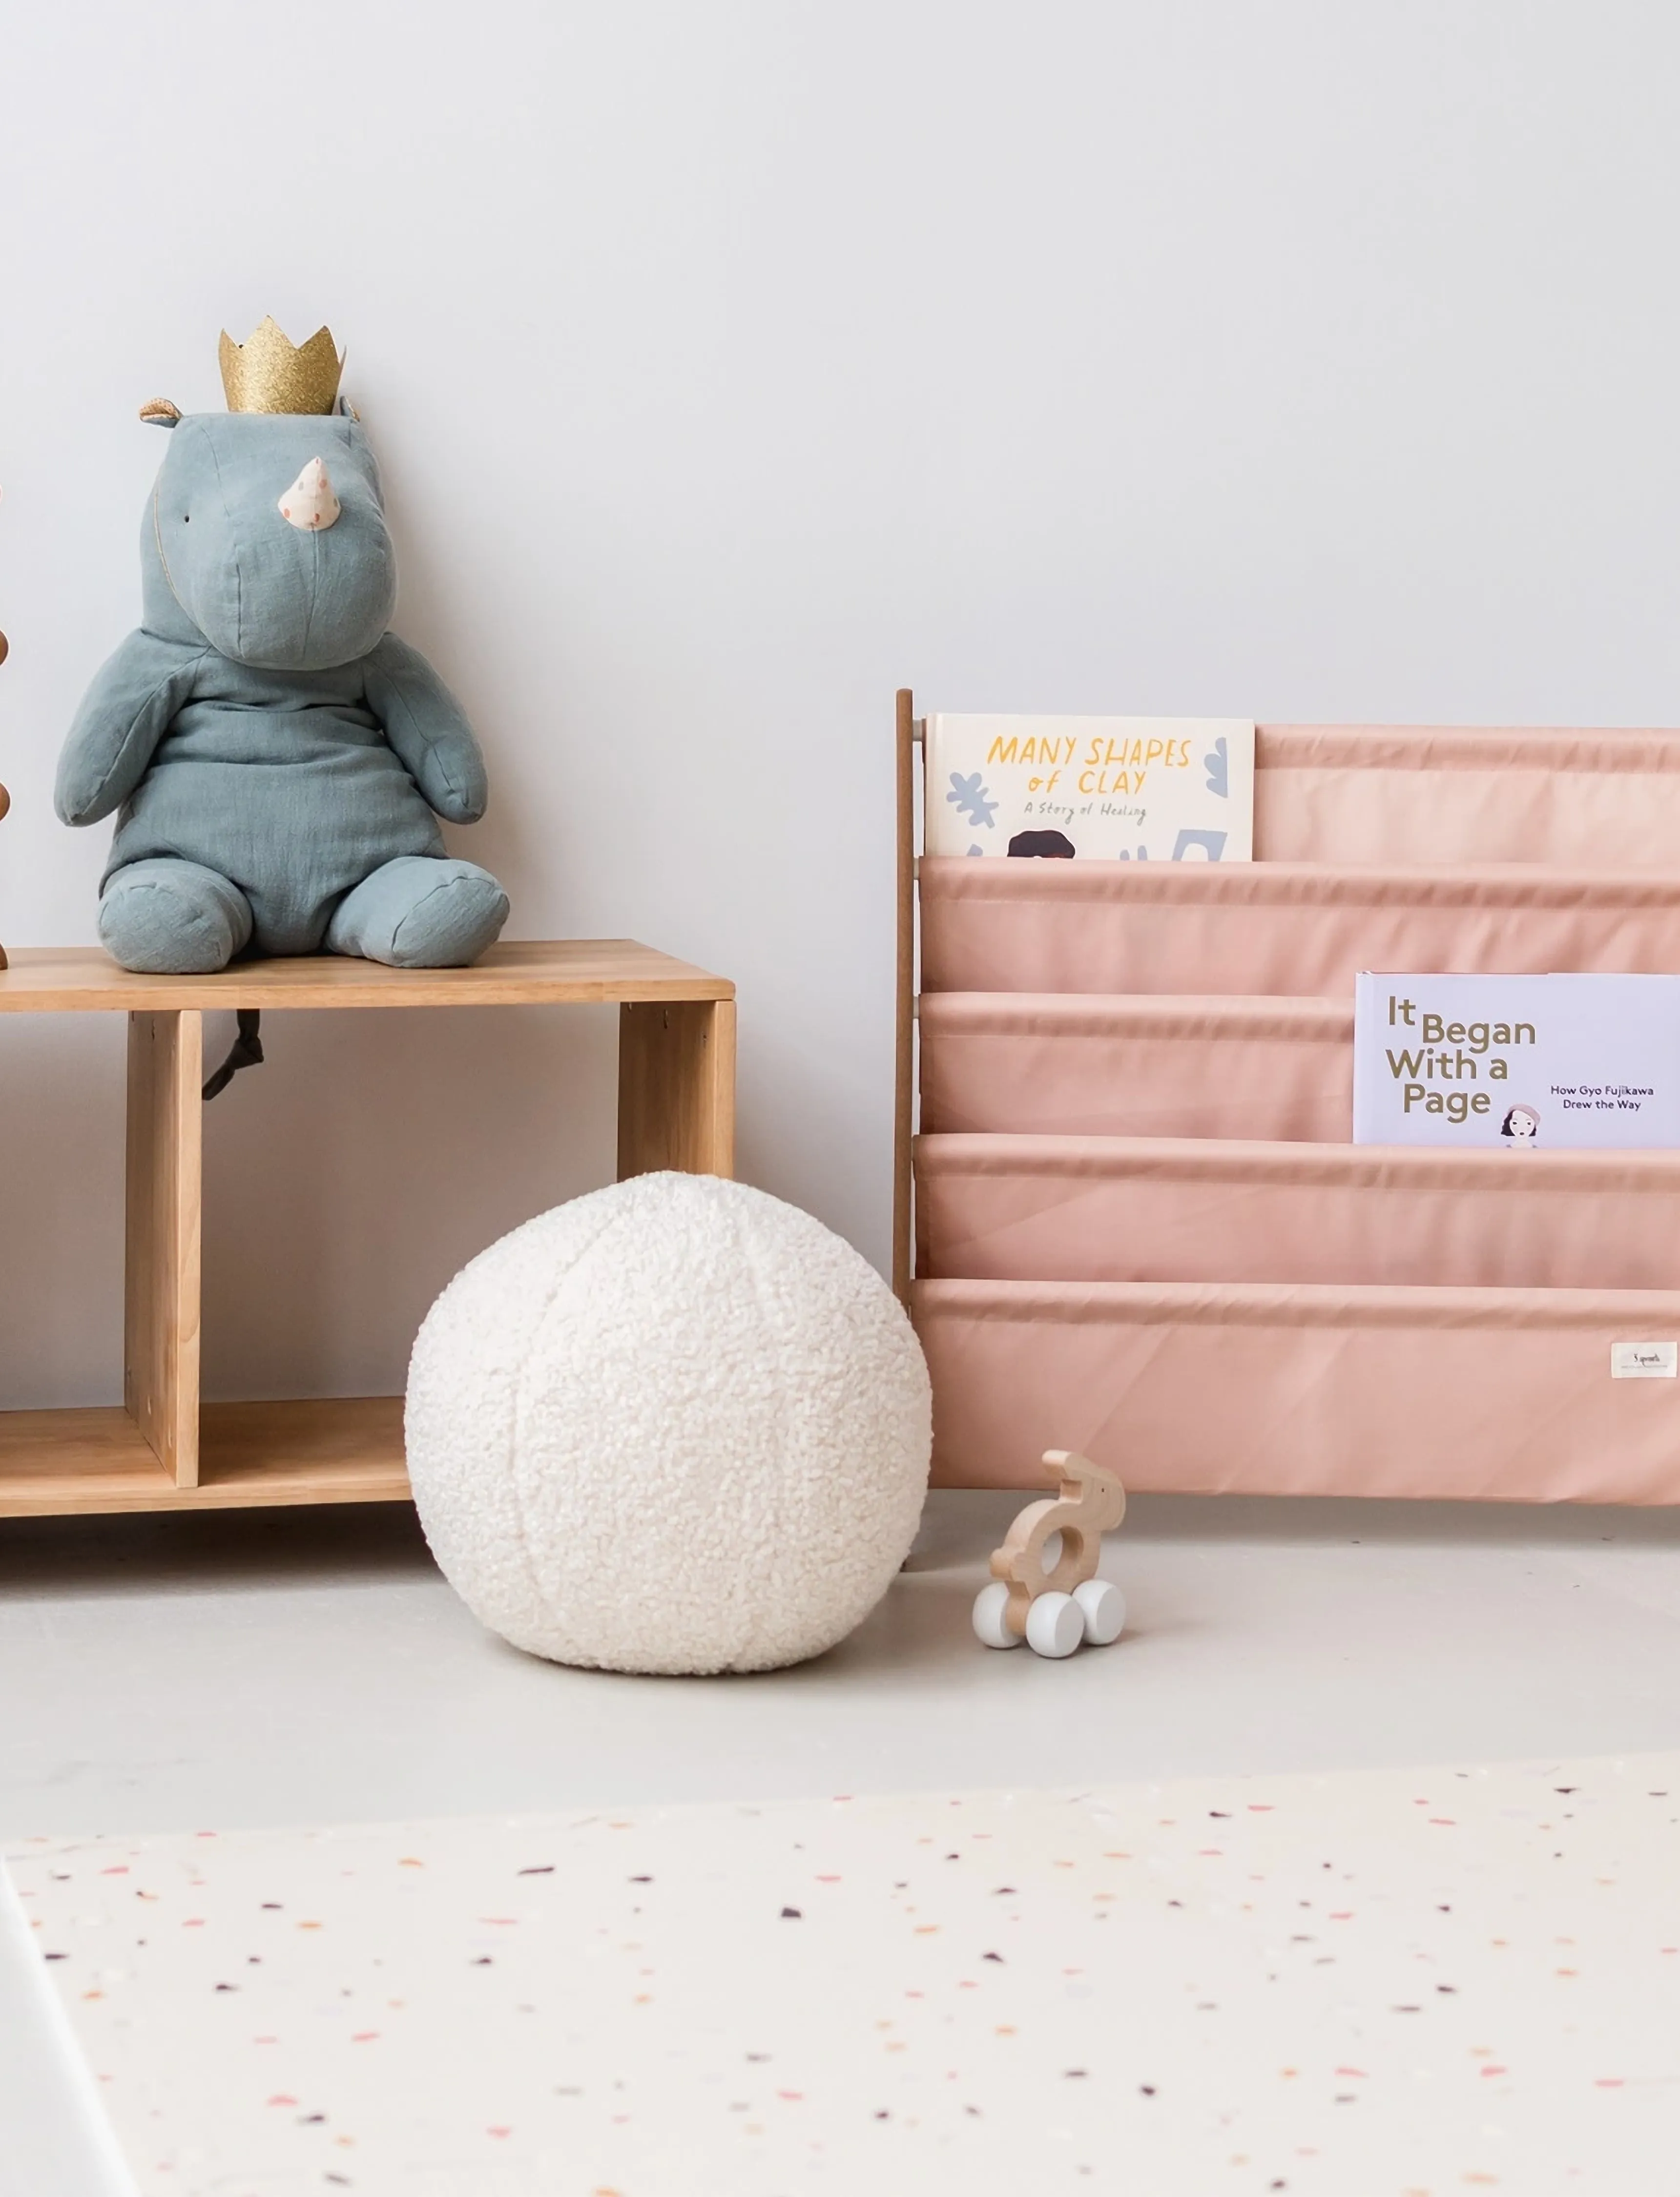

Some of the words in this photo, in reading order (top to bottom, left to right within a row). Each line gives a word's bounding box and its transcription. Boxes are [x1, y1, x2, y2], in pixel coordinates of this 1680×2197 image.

[987, 736, 1076, 765] MANY
[1084, 738, 1191, 767] SHAPES
[1028, 770, 1061, 793] of
[1078, 770, 1146, 795] CLAY
[1024, 802, 1033, 814] A
[1039, 802, 1075, 825] Story
[1389, 995, 1416, 1026] It
[1422, 1014, 1535, 1054] Began
[1386, 1048, 1477, 1079] With
[1489, 1058, 1508, 1079] a
[1404, 1083, 1491, 1123] Page
[1551, 1085, 1576, 1095] How
[1579, 1085, 1602, 1098] Gyo
[1563, 1099, 1592, 1109] Drew
[1595, 1099, 1614, 1109] the
[1617, 1099, 1641, 1111] Way
